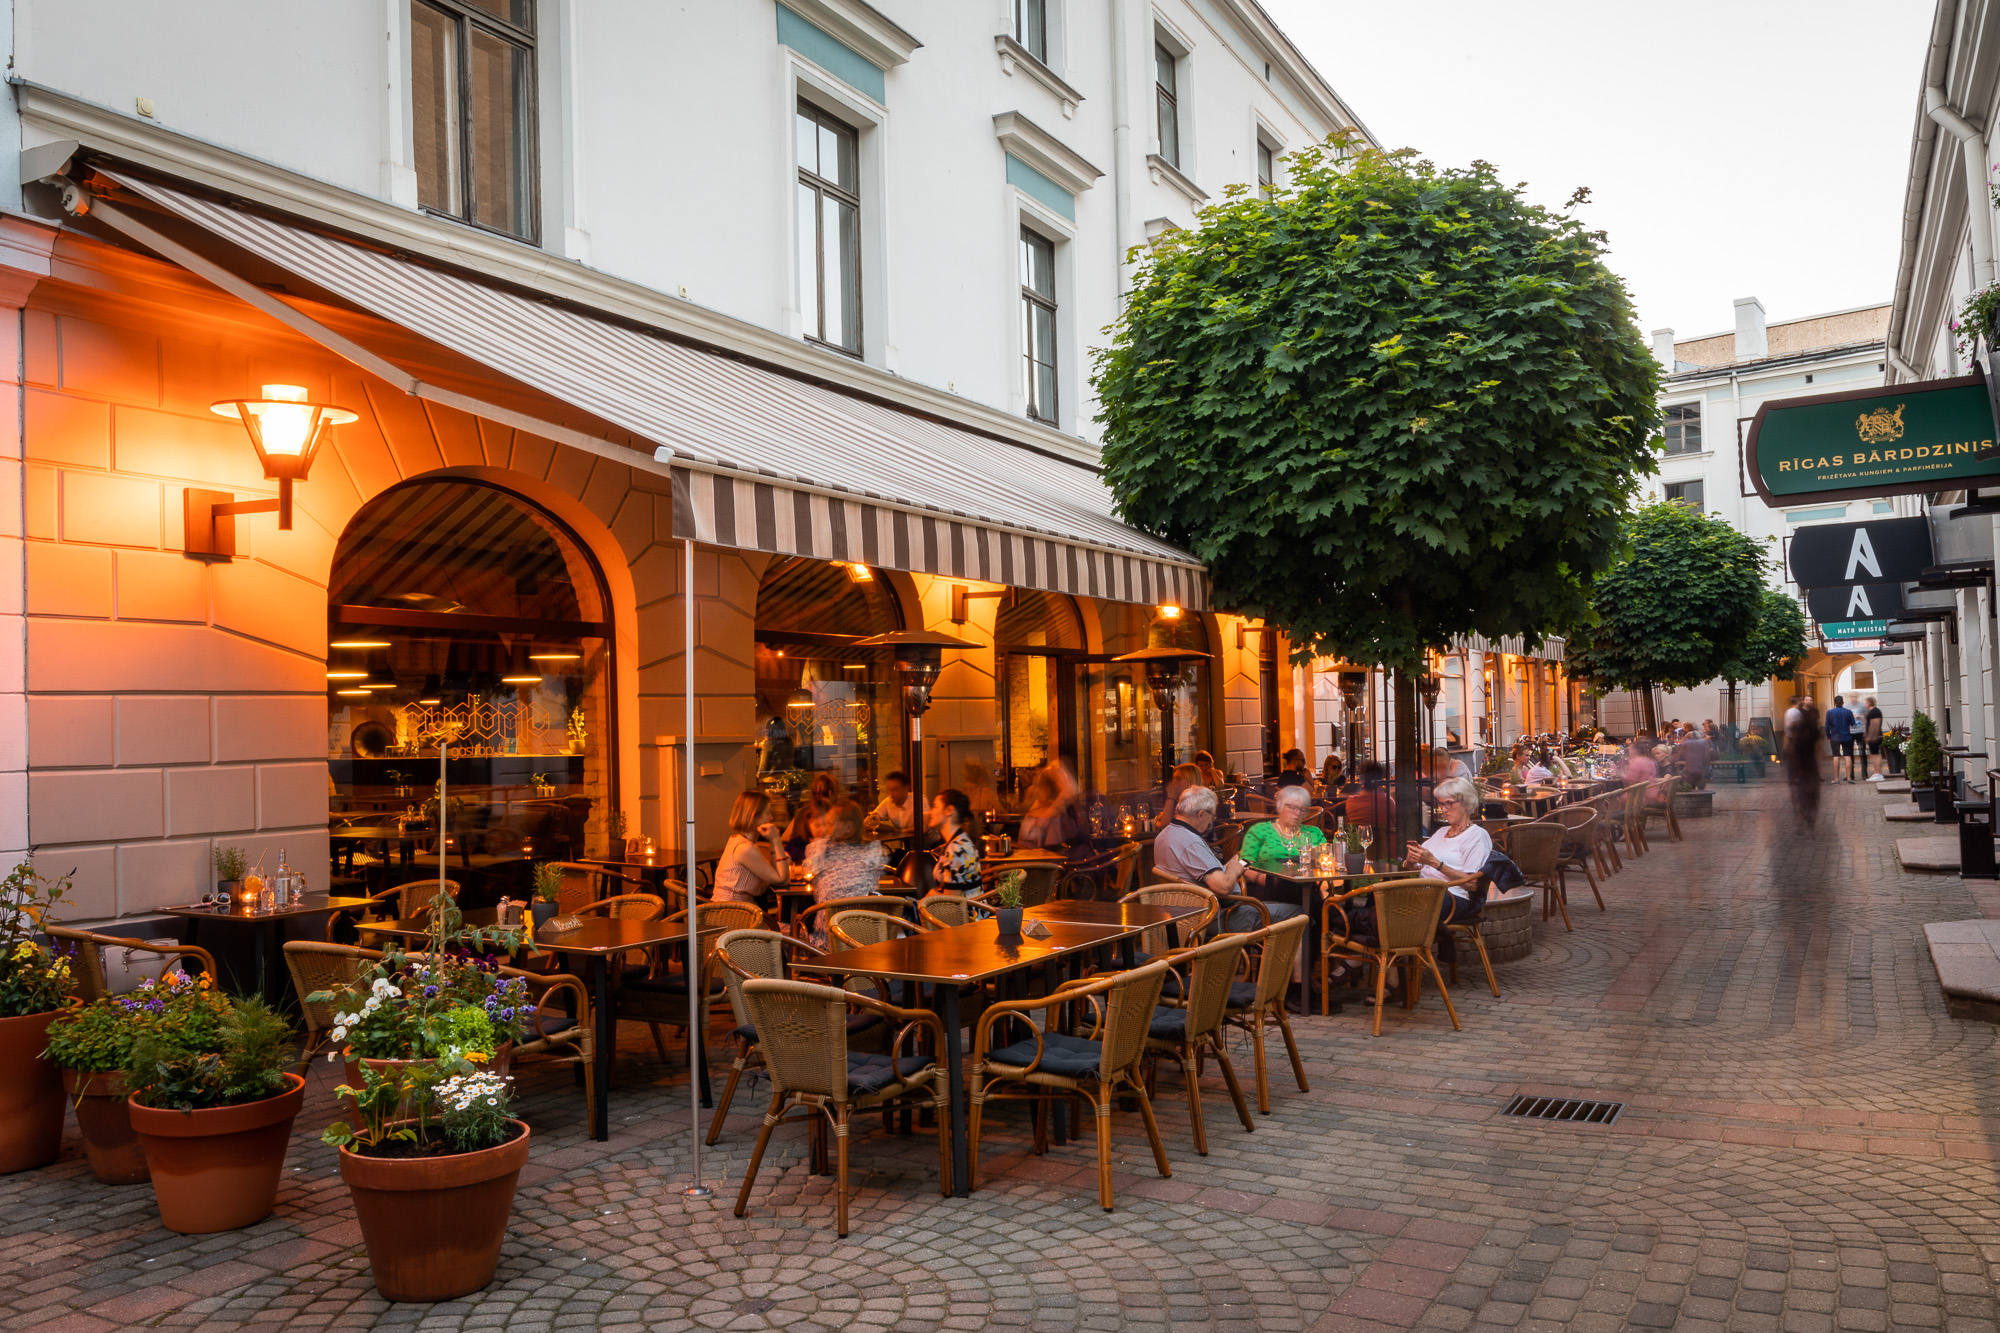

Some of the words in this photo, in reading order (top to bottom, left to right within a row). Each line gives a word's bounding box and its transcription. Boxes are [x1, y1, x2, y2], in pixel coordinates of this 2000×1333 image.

[1779, 456, 1844, 472] RĪGAS
[1853, 439, 1993, 465] BĀRDDZINIS
[1817, 472, 1857, 480] FRIZĒTAVA
[1859, 468, 1893, 476] KUNGIEM
[1902, 463, 1953, 472] PARFIMĒRIJA
